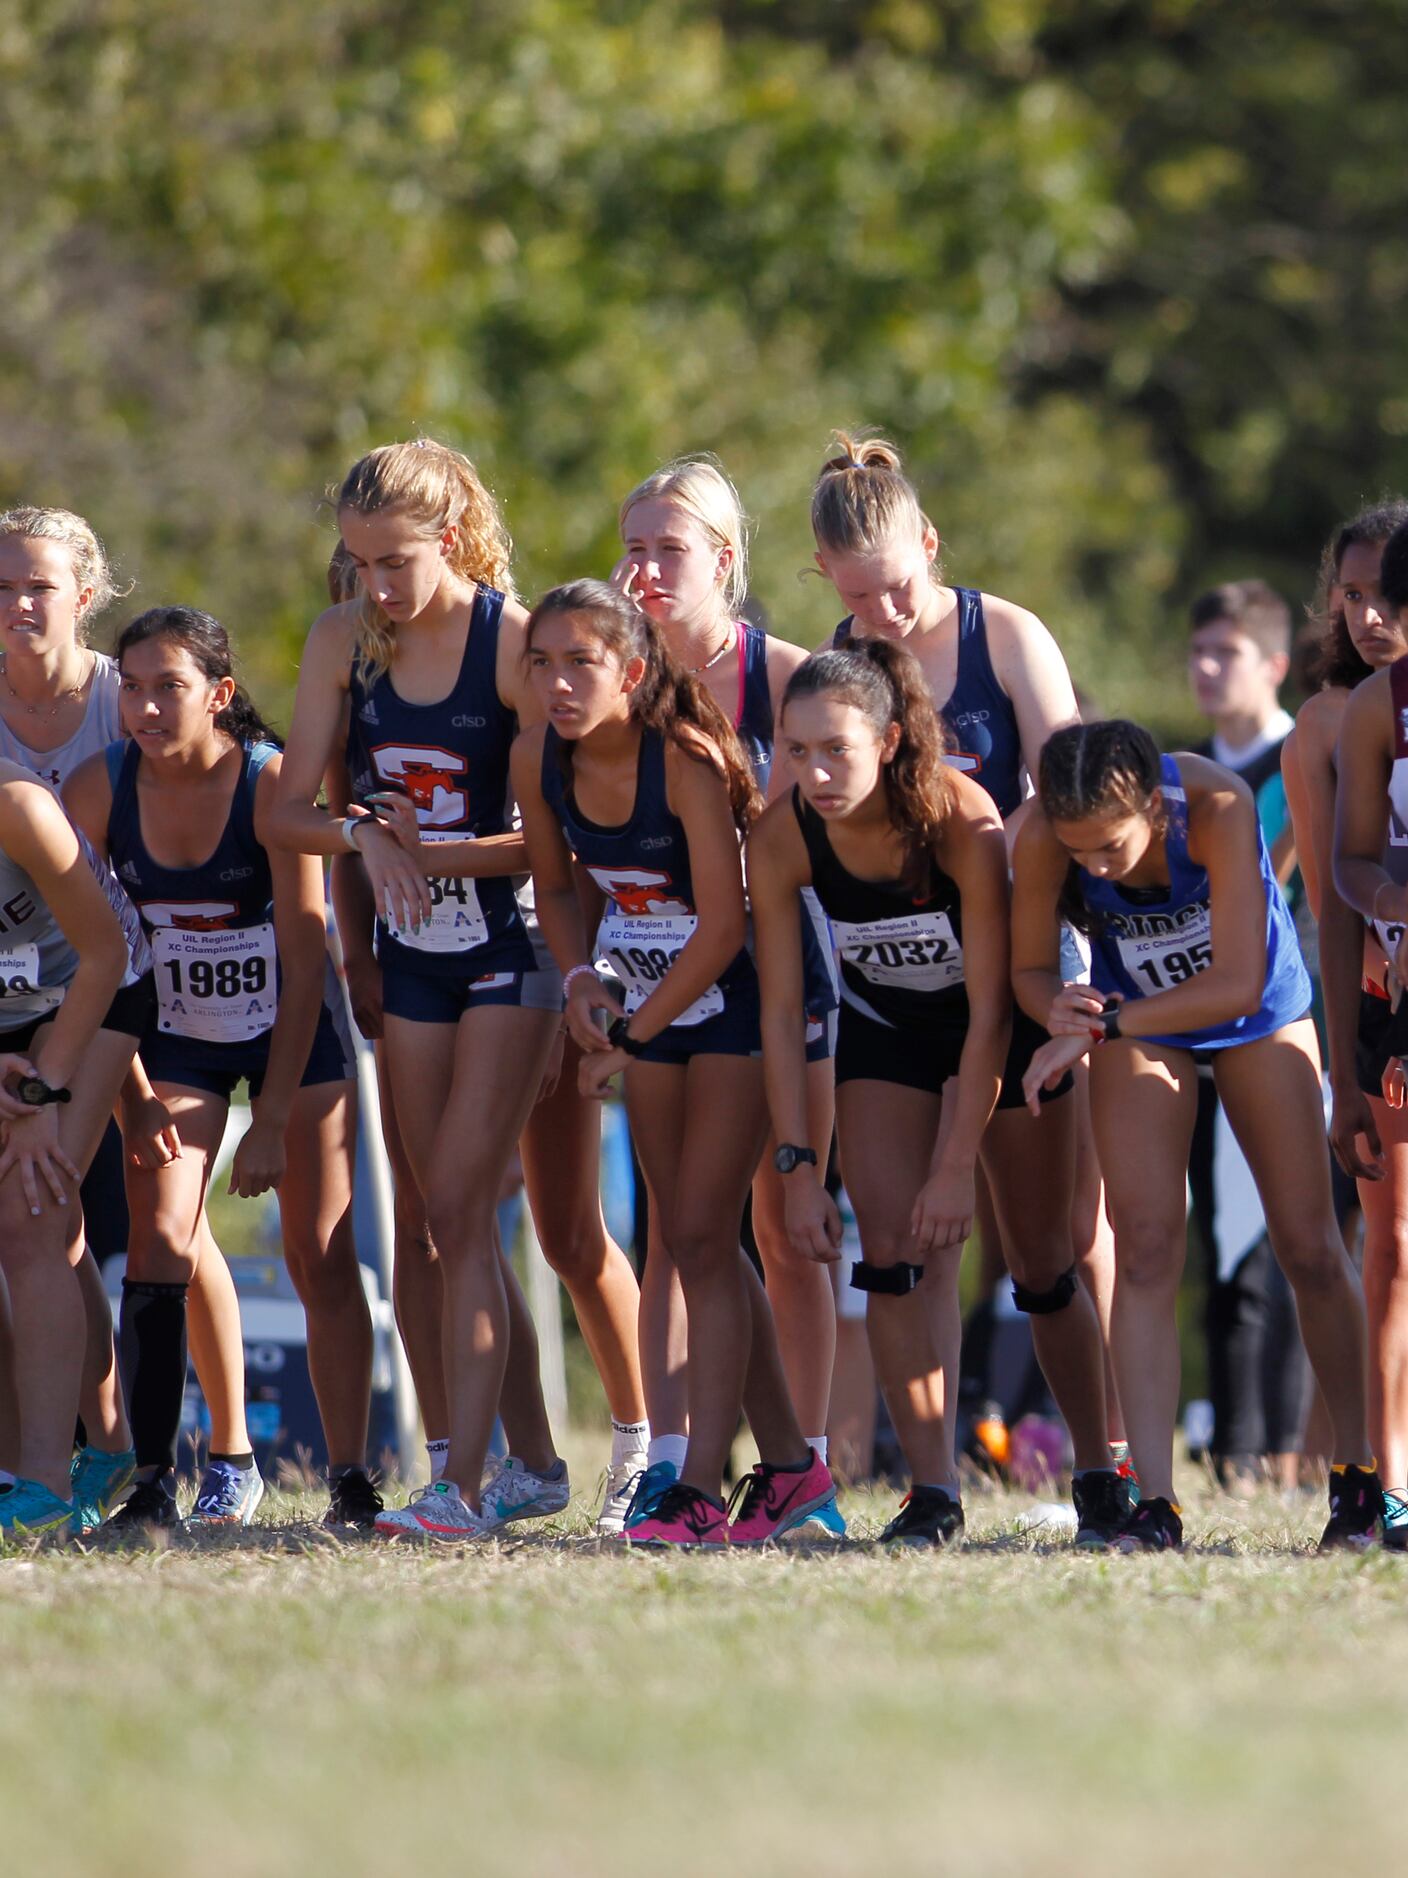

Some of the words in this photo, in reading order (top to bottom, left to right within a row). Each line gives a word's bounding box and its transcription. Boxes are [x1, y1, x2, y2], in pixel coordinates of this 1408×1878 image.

[754, 752, 770, 766] SD
[624, 920, 635, 929] UIL
[637, 920, 663, 930] Region
[666, 920, 672, 928] II
[856, 926, 872, 934] UIL
[875, 922, 909, 932] Region
[182, 934, 198, 943] UIL
[202, 932, 236, 945] Region
[238, 931, 245, 940] II
[609, 931, 621, 939] XC
[624, 931, 686, 942] Championships
[862, 928, 936, 941] Championships
[168, 943, 182, 952] XC
[185, 940, 260, 955] Championships
[849, 939, 958, 968] 2032
[1135, 942, 1151, 953] XC
[1137, 940, 1212, 988] 195
[163, 956, 267, 998] 1989
